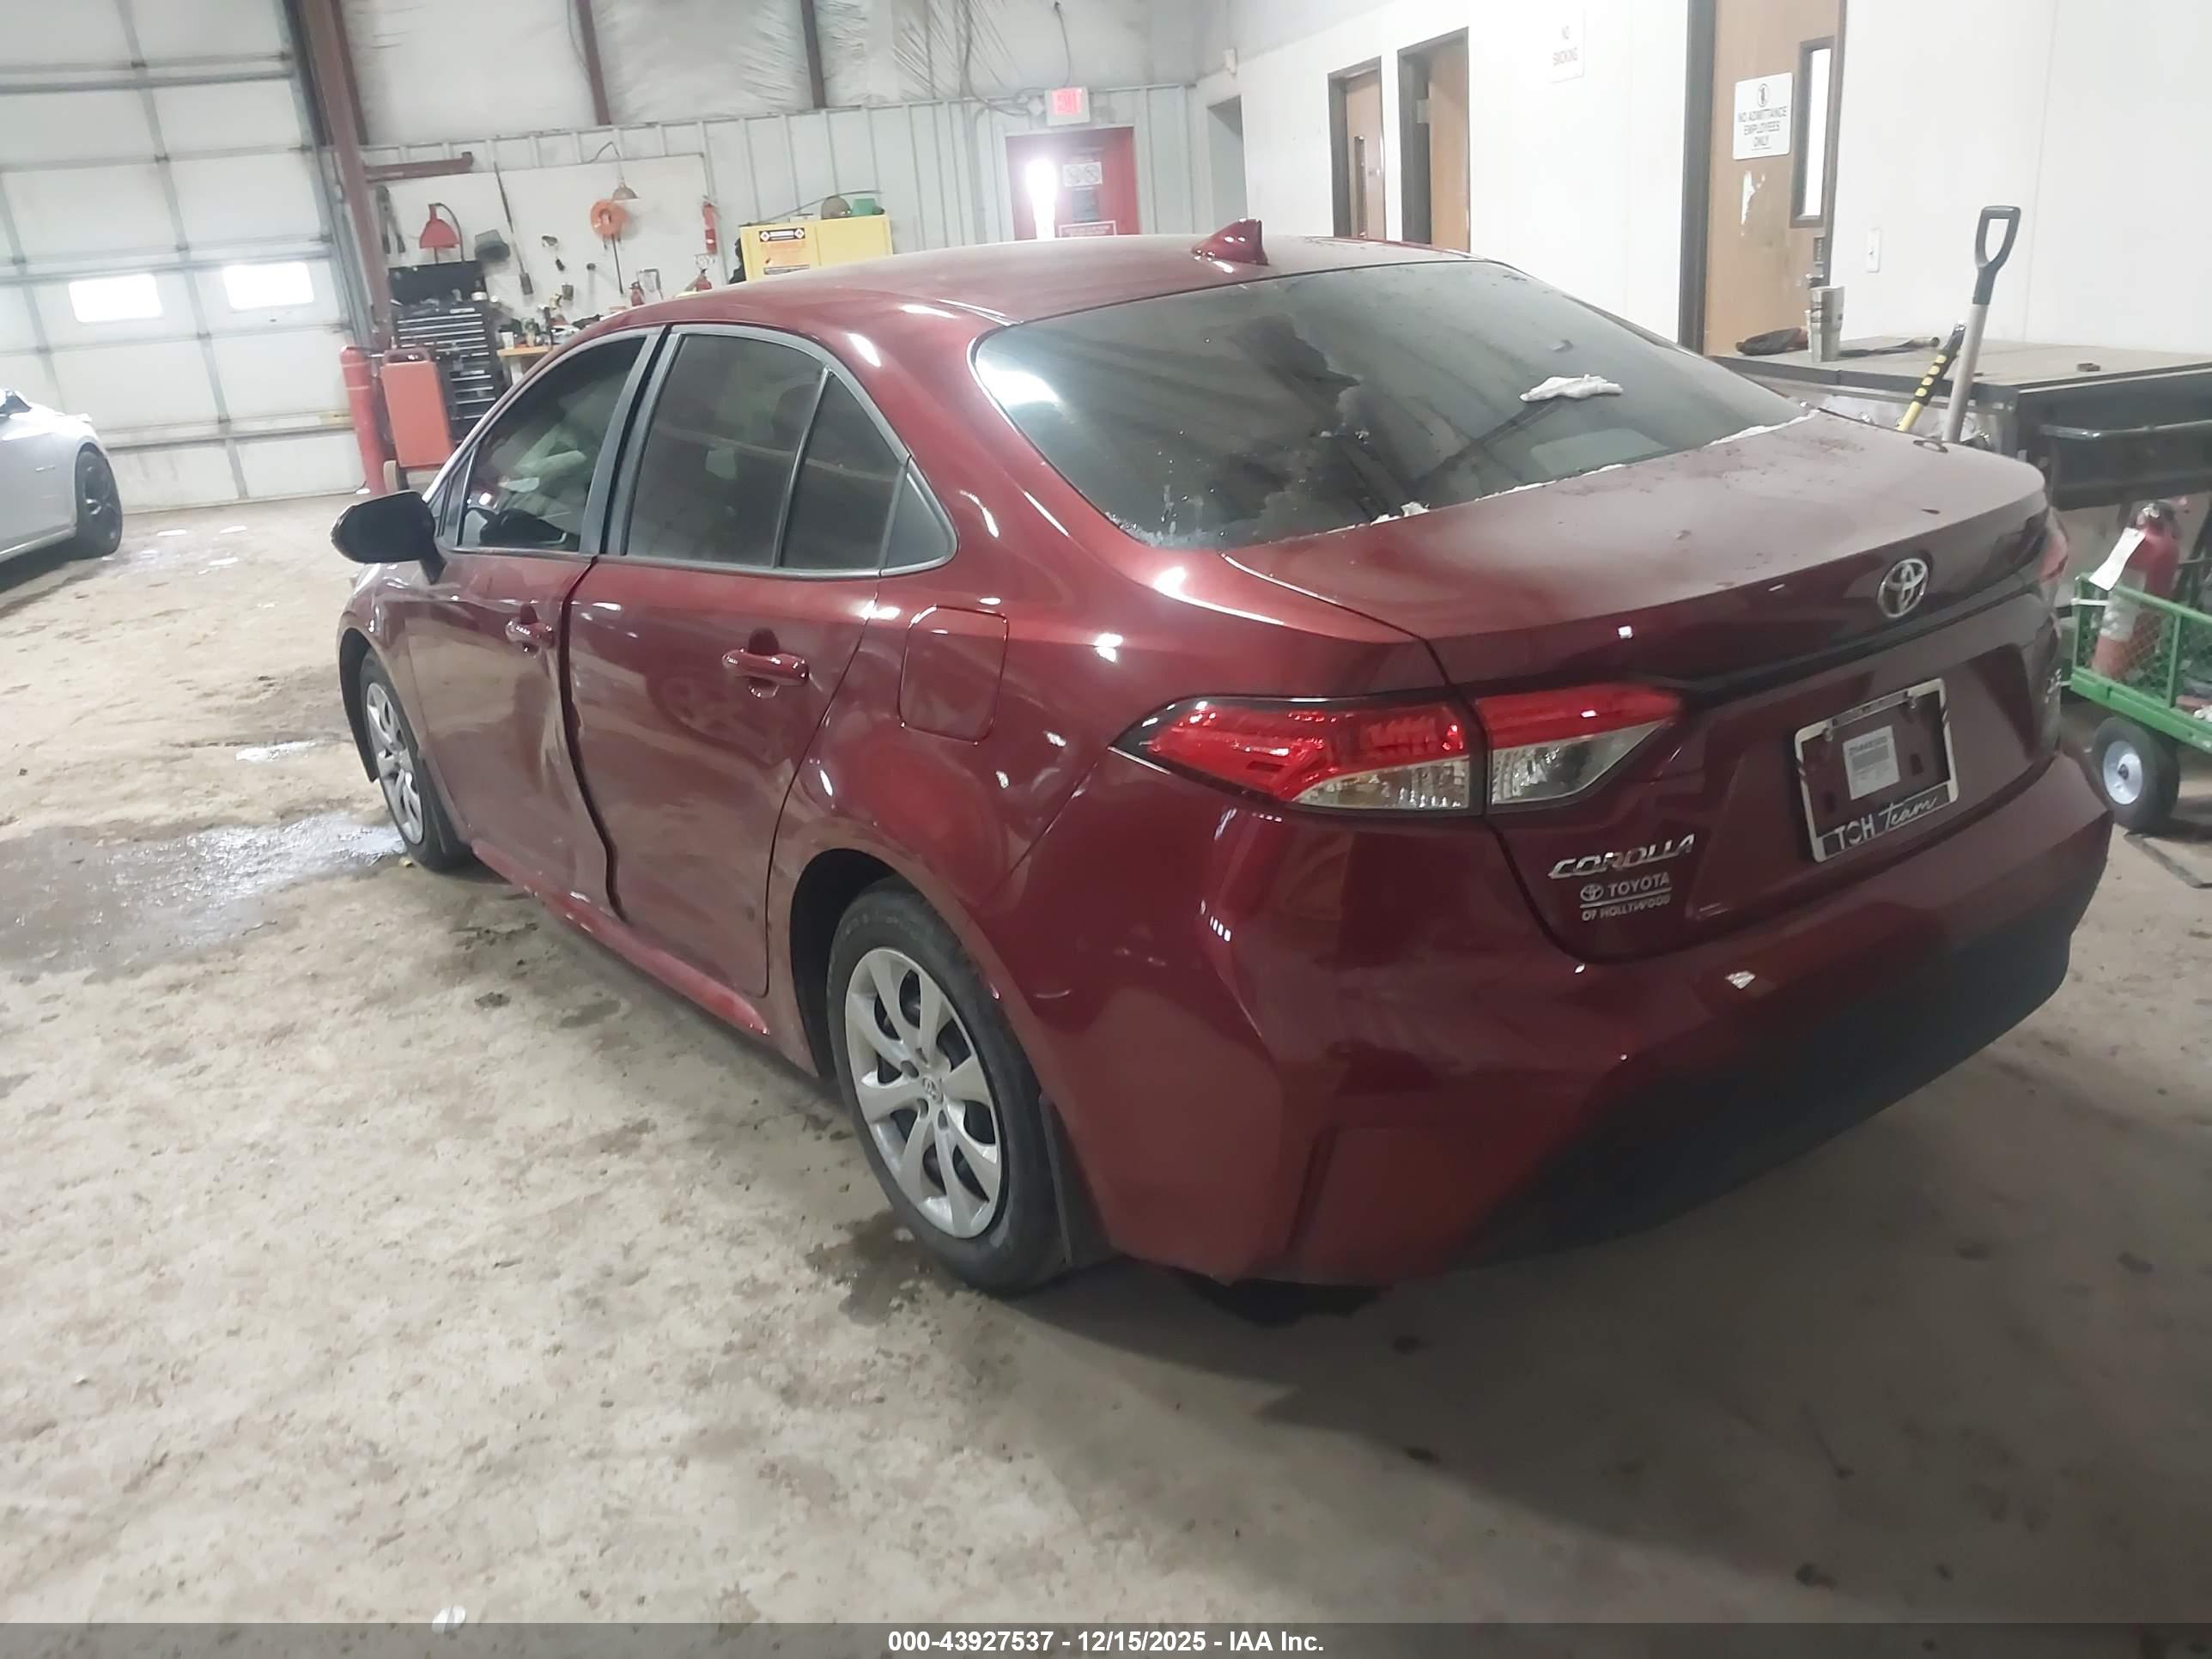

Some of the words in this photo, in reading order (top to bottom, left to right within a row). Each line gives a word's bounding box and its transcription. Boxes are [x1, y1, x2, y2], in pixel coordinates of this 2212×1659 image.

[1560, 25, 1571, 40] NO
[1553, 47, 1578, 66] SMOKING
[1738, 111, 1747, 123] NO
[1749, 106, 1787, 121] ADMITTANCE
[1745, 120, 1780, 136] EMPLOYEES
[1753, 135, 1769, 147] ONLY
[1834, 814, 1876, 850] TCH
[1548, 833, 1695, 879] COROLLA
[1607, 872, 1670, 897] TOYOTA
[1582, 907, 1597, 921] OF
[1600, 894, 1671, 919] HOLLYWOOD
